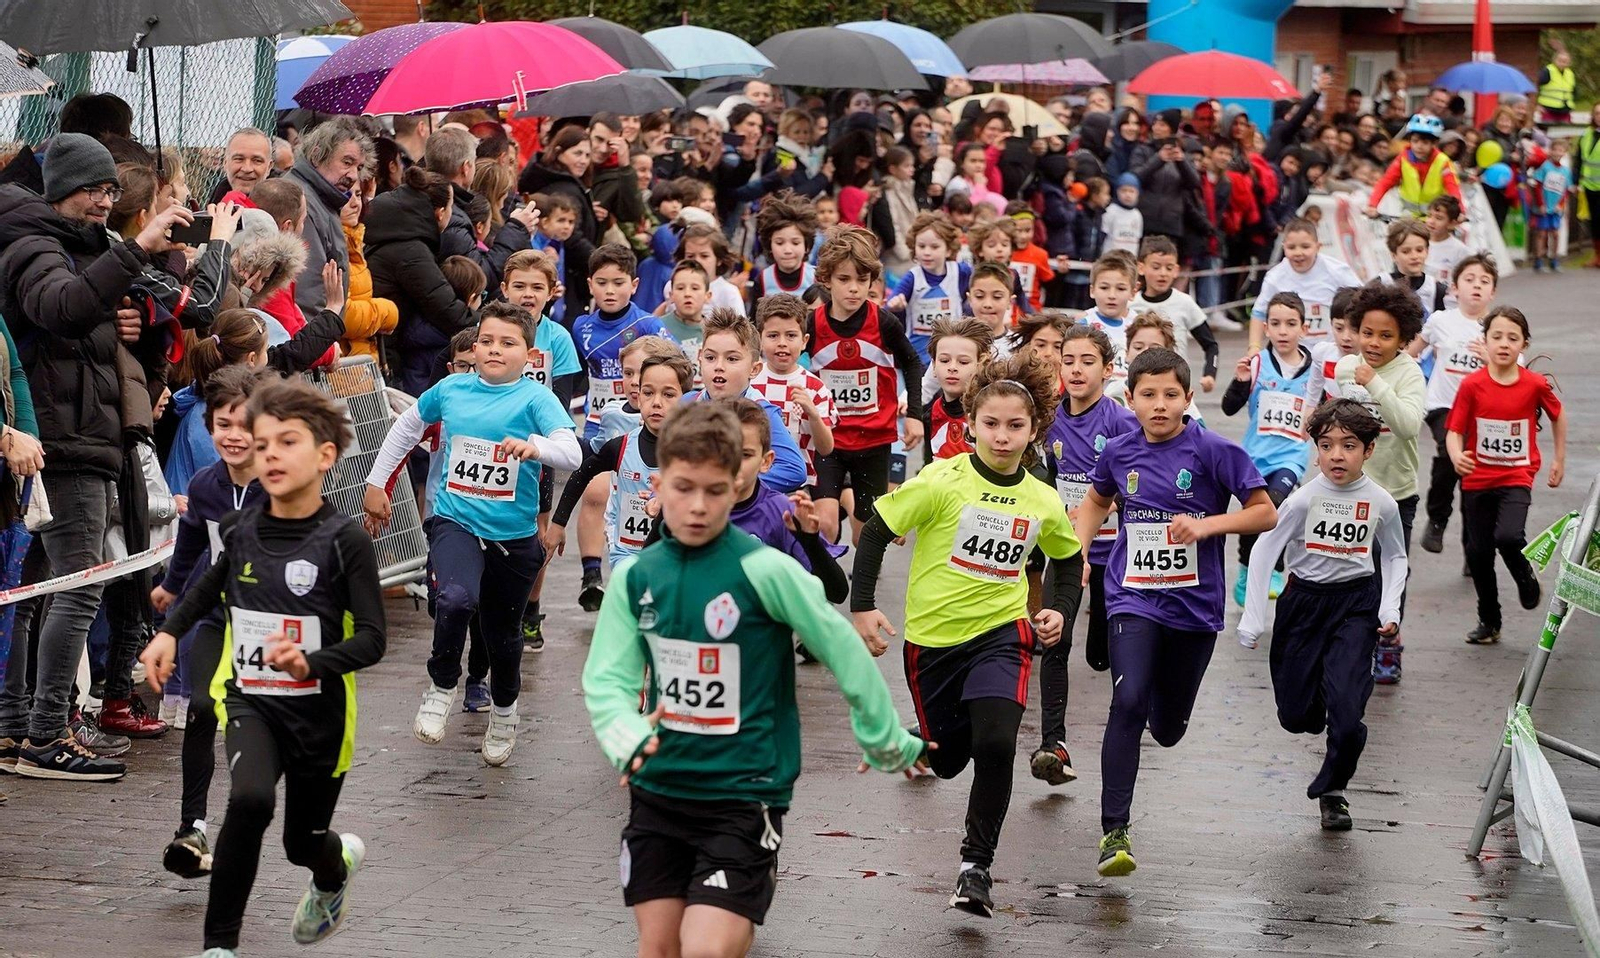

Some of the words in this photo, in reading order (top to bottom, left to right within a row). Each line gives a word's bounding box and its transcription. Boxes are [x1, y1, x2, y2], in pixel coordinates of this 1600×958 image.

[582, 333, 592, 351] 7
[1263, 409, 1302, 429] 4496
[464, 442, 490, 452] CONCELLO
[1481, 437, 1522, 453] 4459
[455, 460, 509, 485] 4473
[980, 492, 1017, 505] Zeus
[1322, 502, 1353, 511] CONCELLO
[976, 514, 1009, 526] CONCELLO
[979, 521, 988, 529] DE
[990, 524, 1004, 532] VIGO
[1313, 520, 1368, 543] 4490
[962, 535, 1025, 565] 4488
[1133, 548, 1188, 571] 4455
